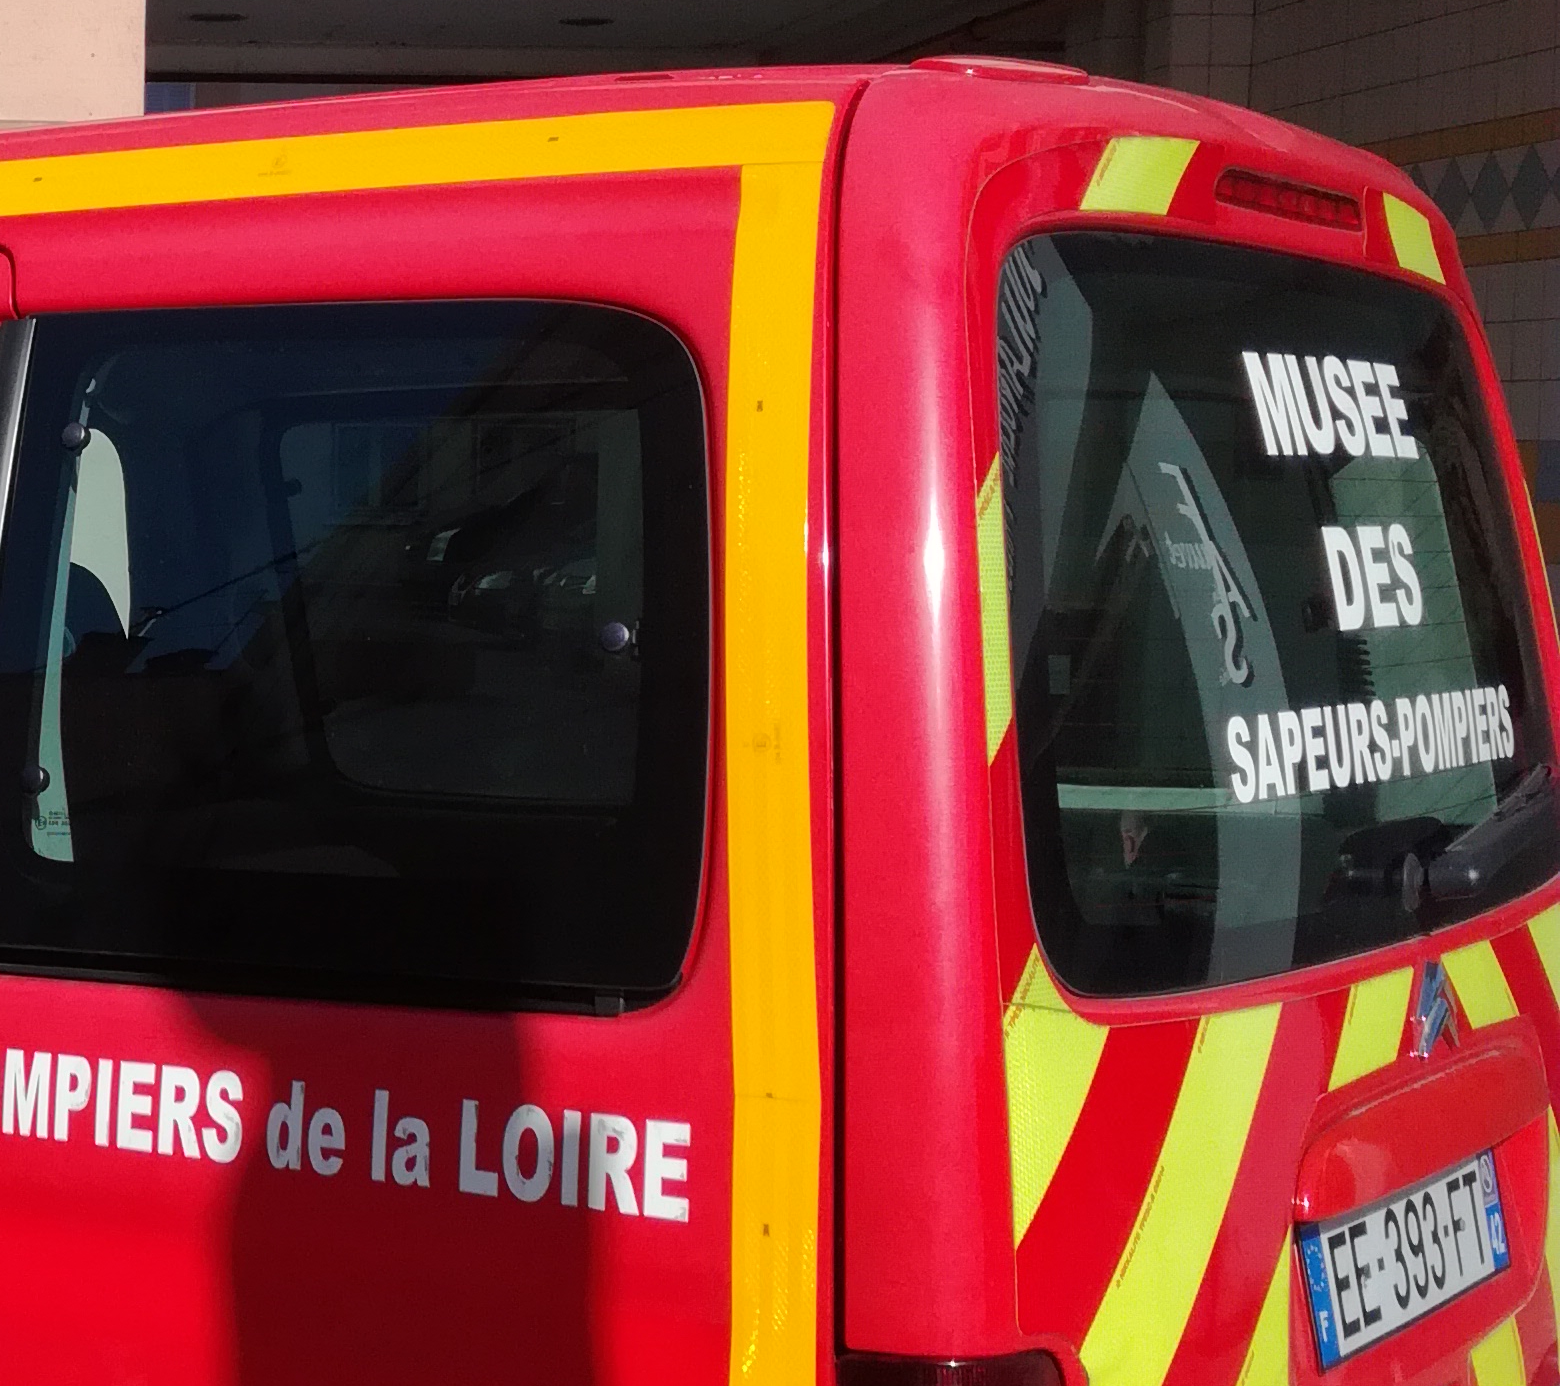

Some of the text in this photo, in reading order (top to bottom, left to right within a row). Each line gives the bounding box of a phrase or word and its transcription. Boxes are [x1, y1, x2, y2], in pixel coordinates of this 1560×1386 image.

[1241, 350, 1419, 460] MUSEE
[1320, 522, 1424, 632] DES
[1226, 683, 1516, 804] SAPEURS-POMPIERS
[265, 1079, 346, 1177] de
[370, 1088, 431, 1189] la
[457, 1097, 692, 1224] LOIRE
[1318, 1168, 1507, 1343] F EE-393-FT 42
